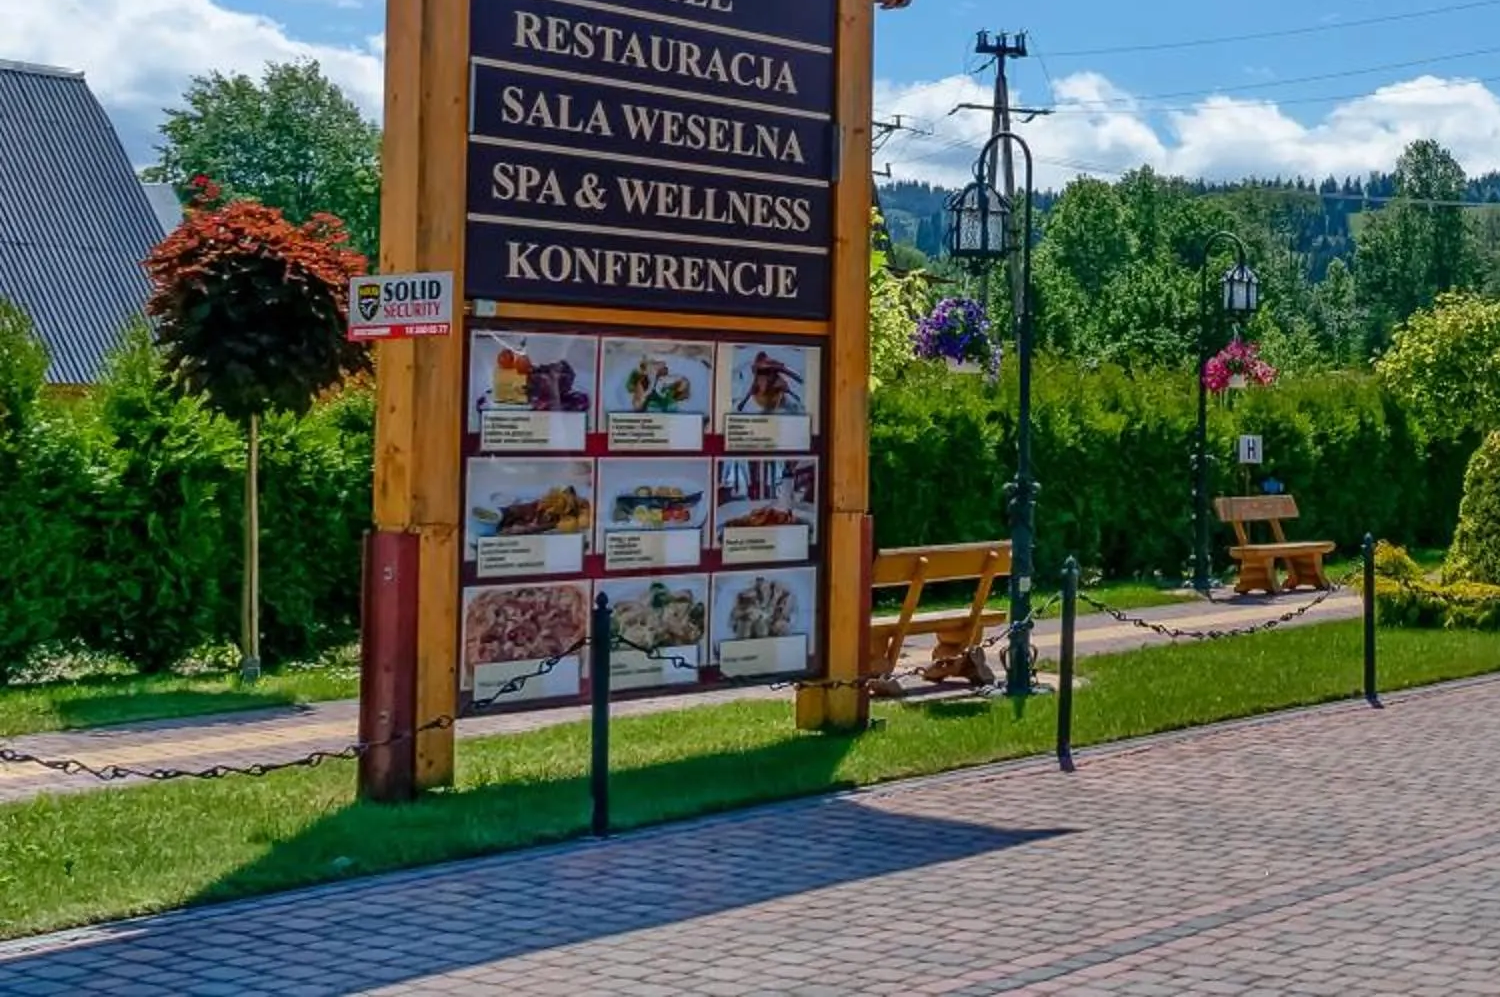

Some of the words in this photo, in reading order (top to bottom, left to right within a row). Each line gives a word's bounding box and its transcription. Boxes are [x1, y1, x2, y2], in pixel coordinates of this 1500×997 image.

[512, 10, 799, 95] RESTAURACJA
[501, 85, 615, 137] SALA
[621, 104, 806, 164] WESELNA
[491, 161, 567, 207] SPA
[575, 172, 608, 212] &
[617, 178, 811, 233] WELLNESS
[383, 280, 442, 302] SOLID
[506, 241, 799, 299] KONFERENCJE
[383, 302, 441, 318] SECURITY
[1247, 438, 1257, 460] H
